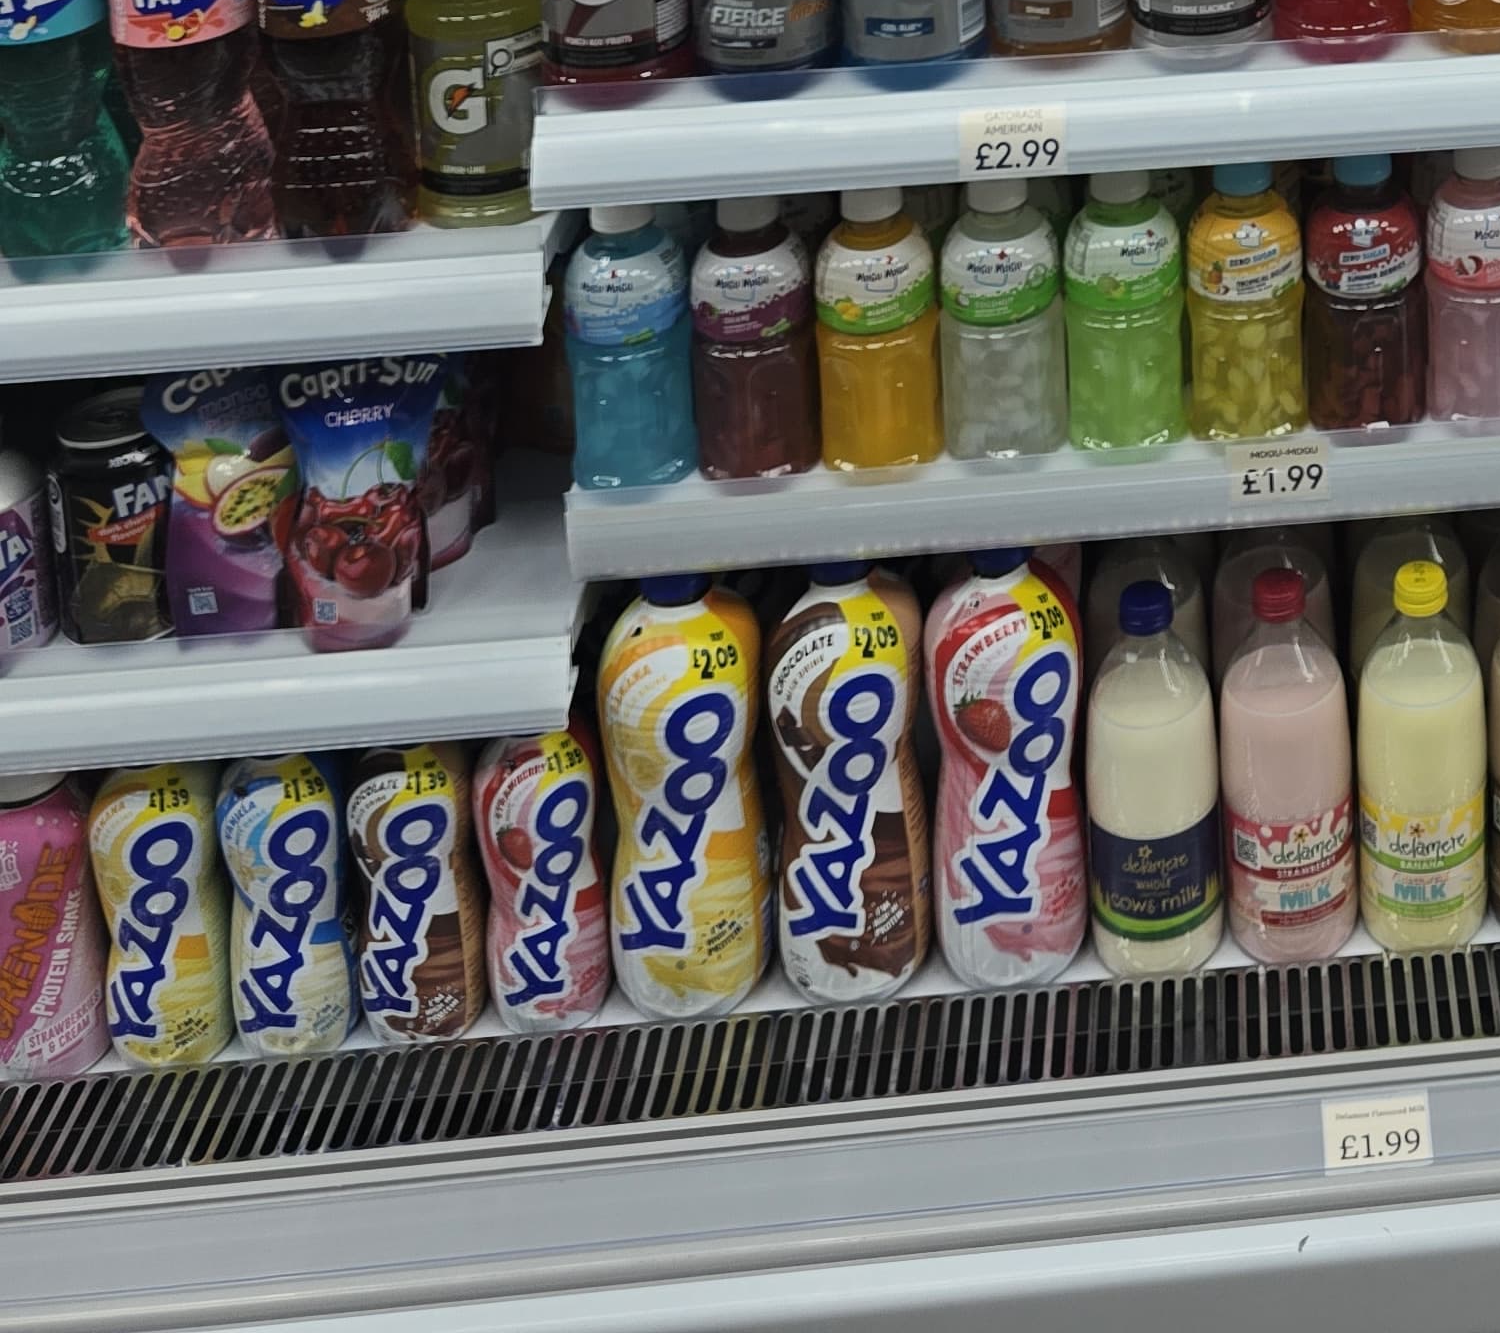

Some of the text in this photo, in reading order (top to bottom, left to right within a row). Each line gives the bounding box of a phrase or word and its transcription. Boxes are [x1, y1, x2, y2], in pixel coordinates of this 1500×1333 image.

[710, 6, 786, 27] FIERCE
[429, 68, 487, 135] G
[974, 137, 1061, 172] £2.99
[279, 357, 437, 409] Capri-Sun
[324, 402, 395, 429] CHERRY
[1242, 463, 1324, 495] £1.99
[1031, 606, 1065, 640] £2.09
[853, 624, 900, 659] £2.09
[692, 644, 739, 681] £2.09
[772, 633, 835, 698] CHOCOLATE
[149, 786, 189, 815] £1.39
[284, 775, 325, 804] £1.39
[621, 691, 736, 952] YAZOO
[1389, 833, 1467, 859] delamere
[1398, 857, 1446, 871] BANANA
[240, 809, 331, 1035] YAZOO
[362, 804, 449, 1014] YAZOO
[110, 820, 195, 1038] YAZOO
[30, 887, 82, 1019] PROTEIN SHAKE
[1340, 1128, 1421, 1160] £1.99
